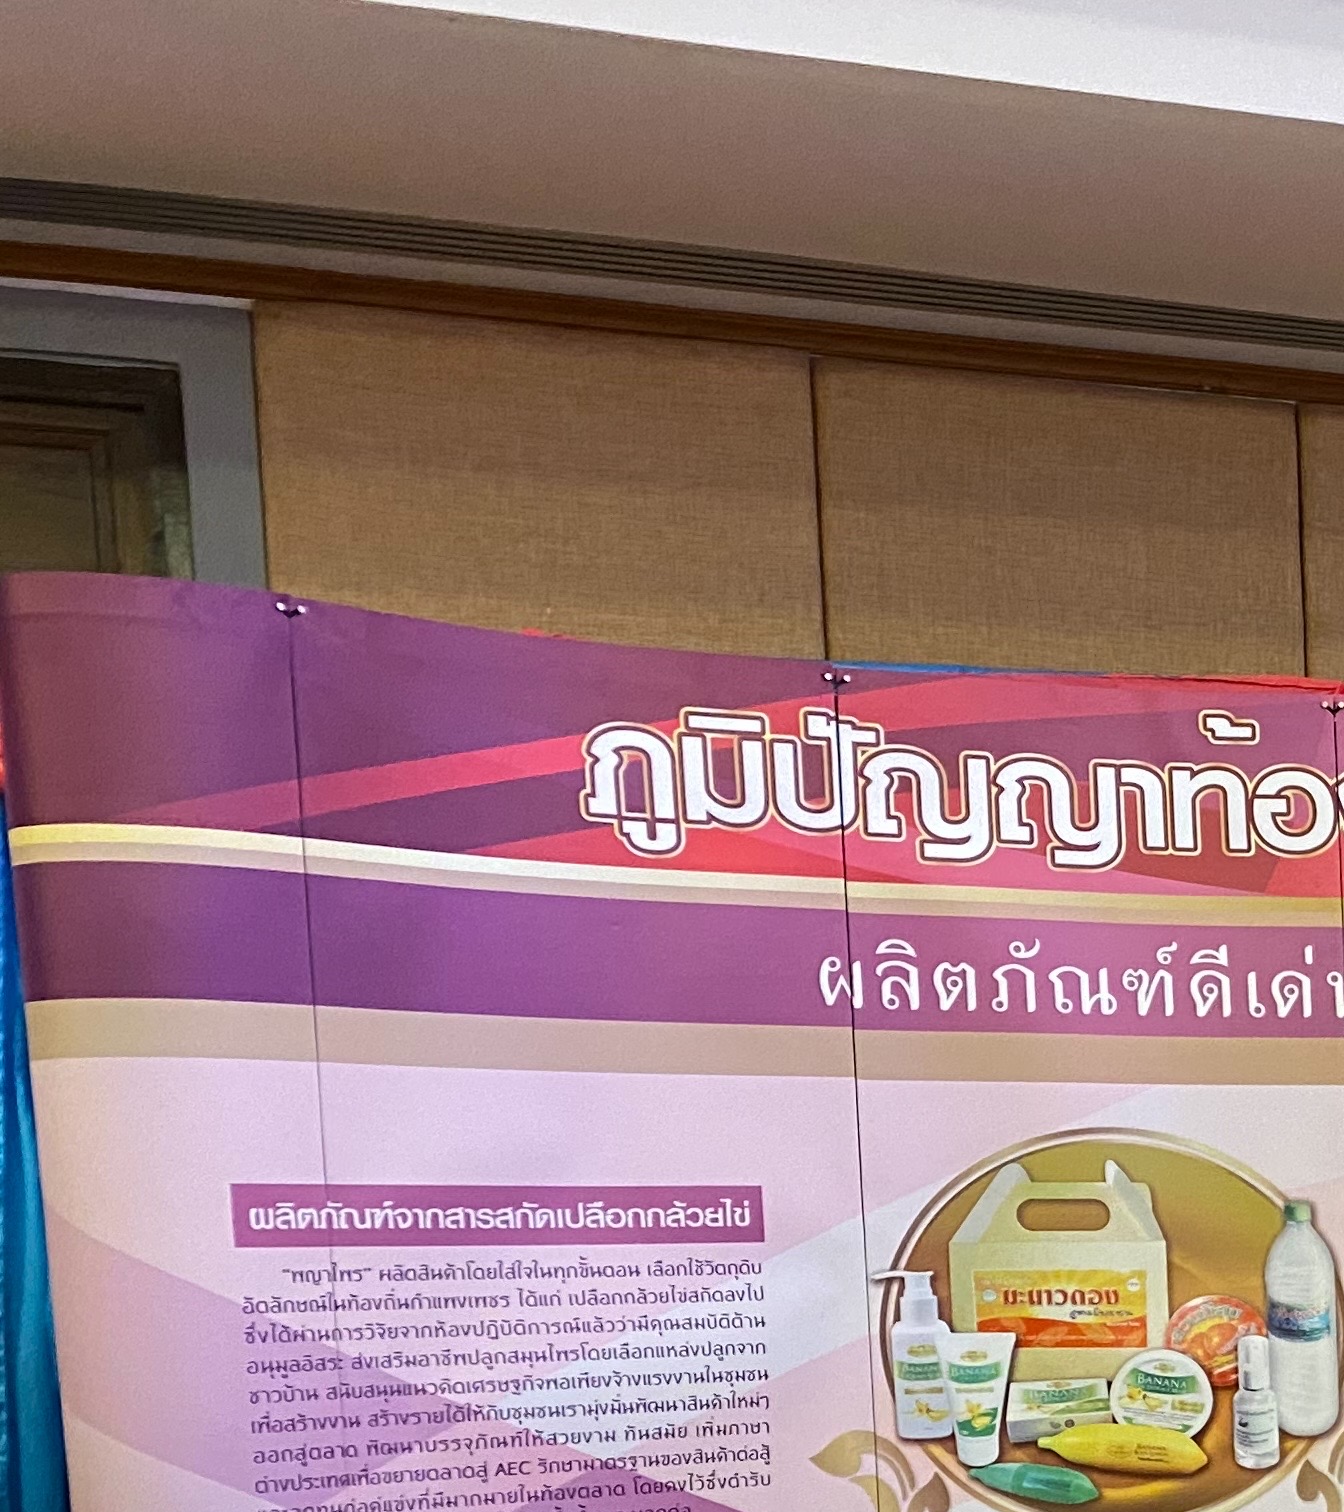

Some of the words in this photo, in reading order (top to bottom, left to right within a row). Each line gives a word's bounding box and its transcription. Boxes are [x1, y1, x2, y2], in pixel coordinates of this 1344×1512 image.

[249, 1198, 751, 1230] ผลิตภัณฑ์จากสารสกัดเปลือกกล้วยไข่
[248, 1384, 319, 1405] ชาวบ้าน
[494, 1460, 532, 1477] AEC
